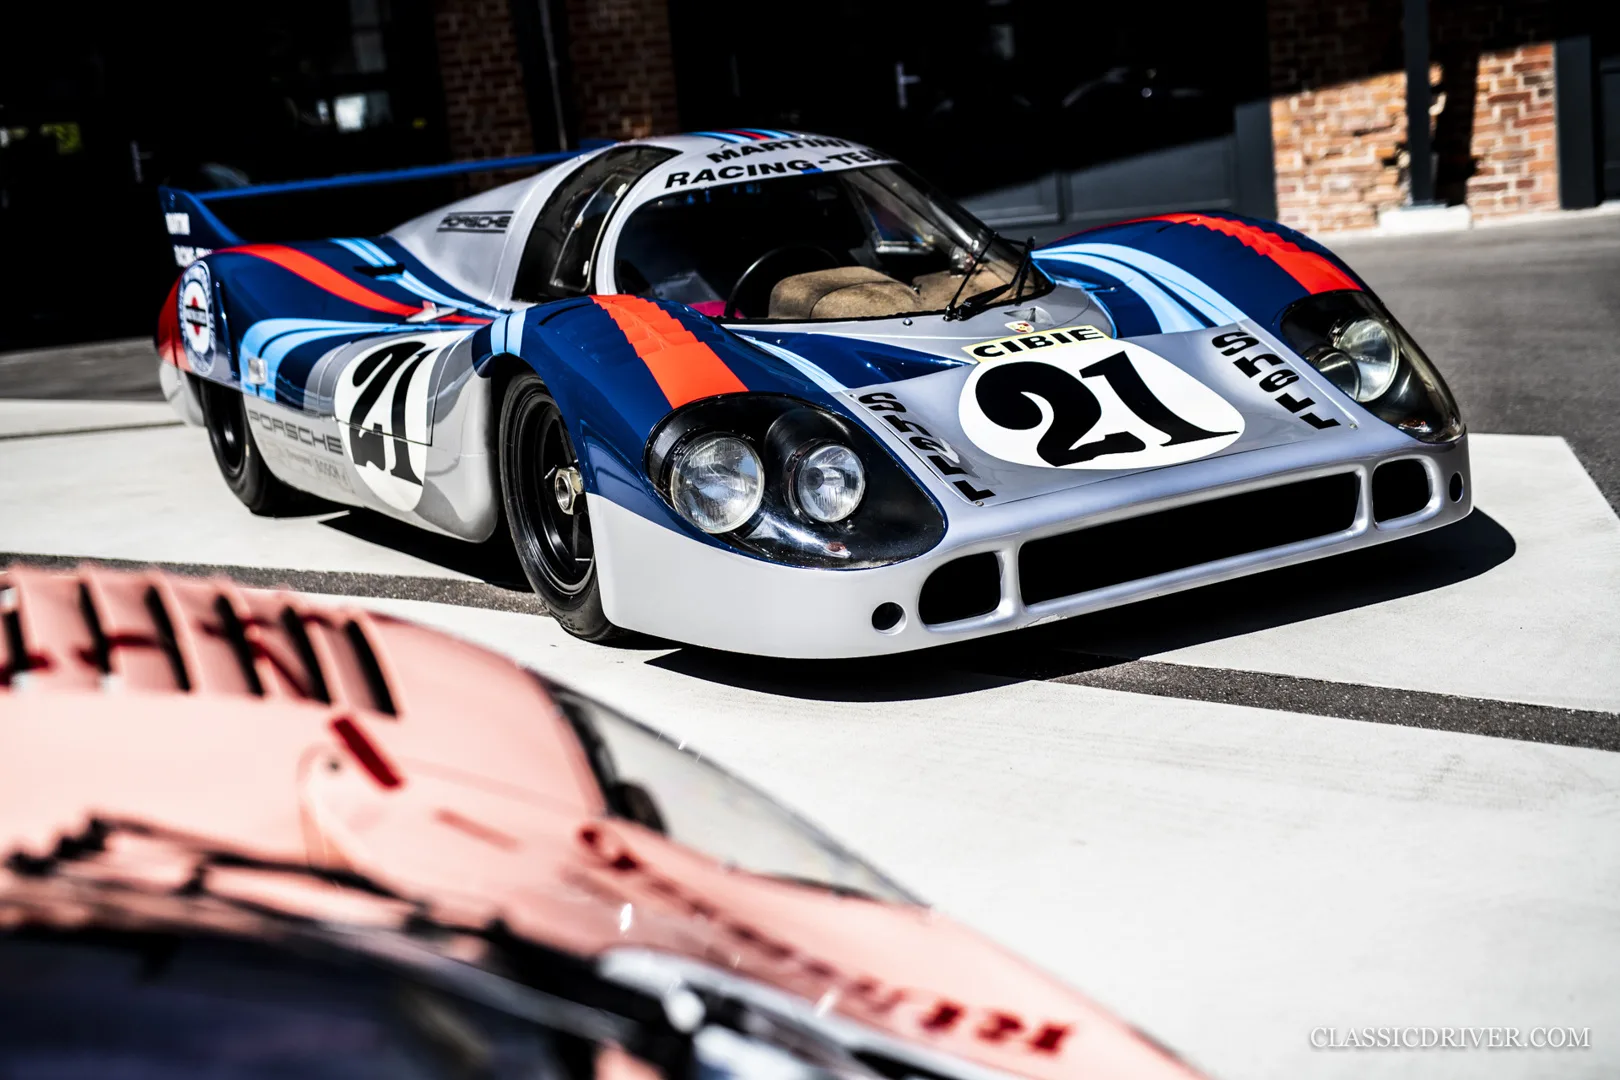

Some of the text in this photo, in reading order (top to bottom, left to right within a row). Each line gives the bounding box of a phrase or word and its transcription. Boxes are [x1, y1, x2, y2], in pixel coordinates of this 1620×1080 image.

[706, 141, 854, 164] MARTINI
[248, 409, 344, 456] PORSCHE
[349, 341, 437, 488] 21
[974, 350, 1239, 467] 21
